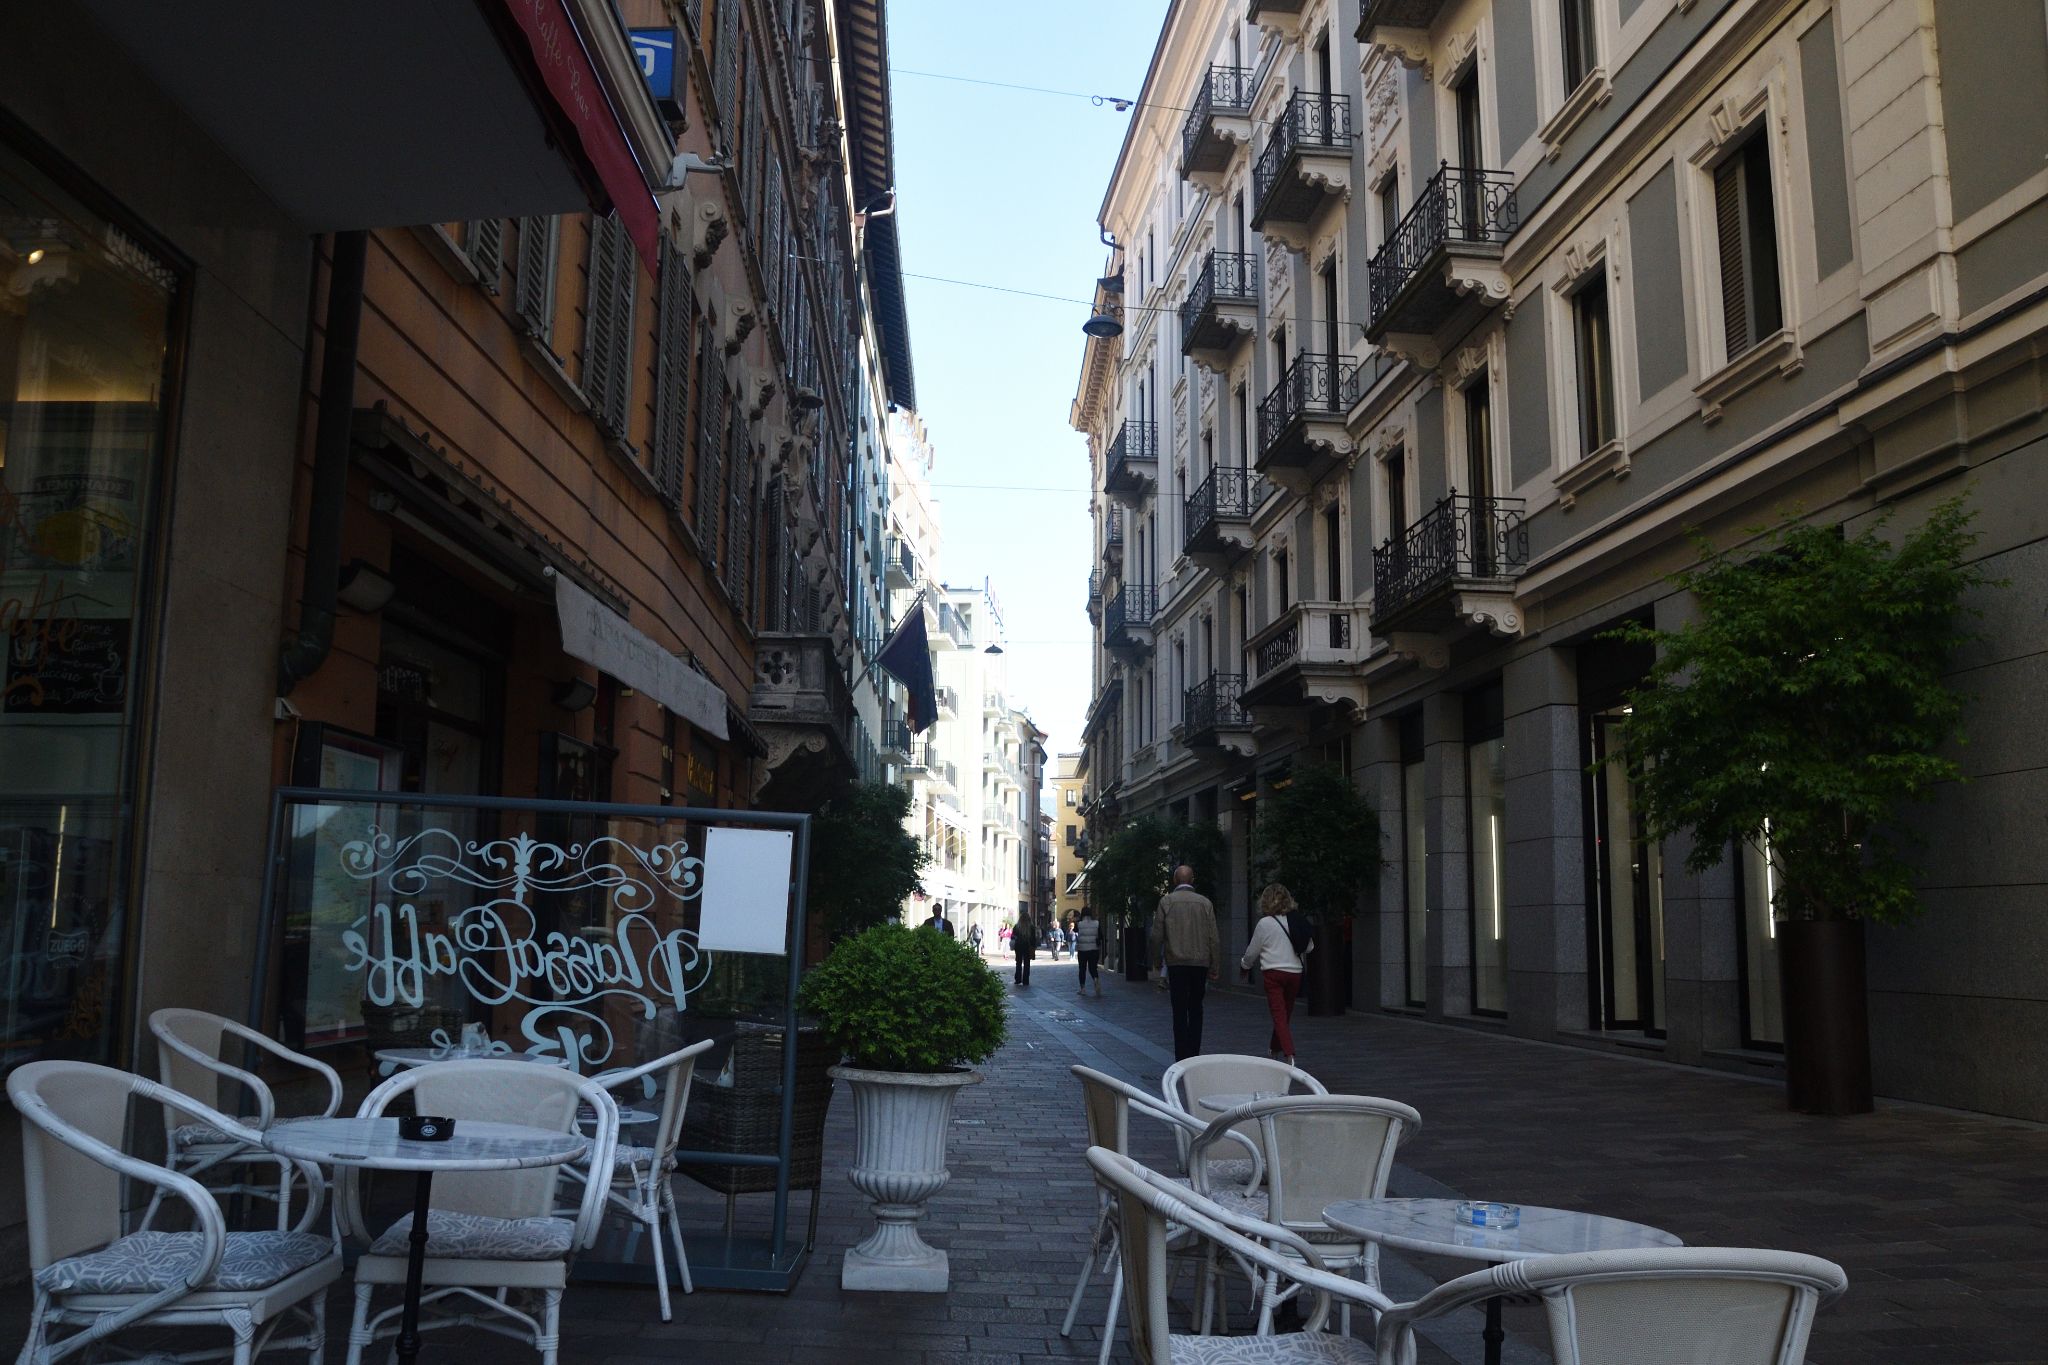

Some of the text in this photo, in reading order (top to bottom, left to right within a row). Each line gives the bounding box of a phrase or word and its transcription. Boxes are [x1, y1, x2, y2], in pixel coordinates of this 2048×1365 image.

[567, 55, 591, 120] Bar
[36, 479, 127, 494] LEMONADE
[49, 939, 86, 953] ZUEGG
